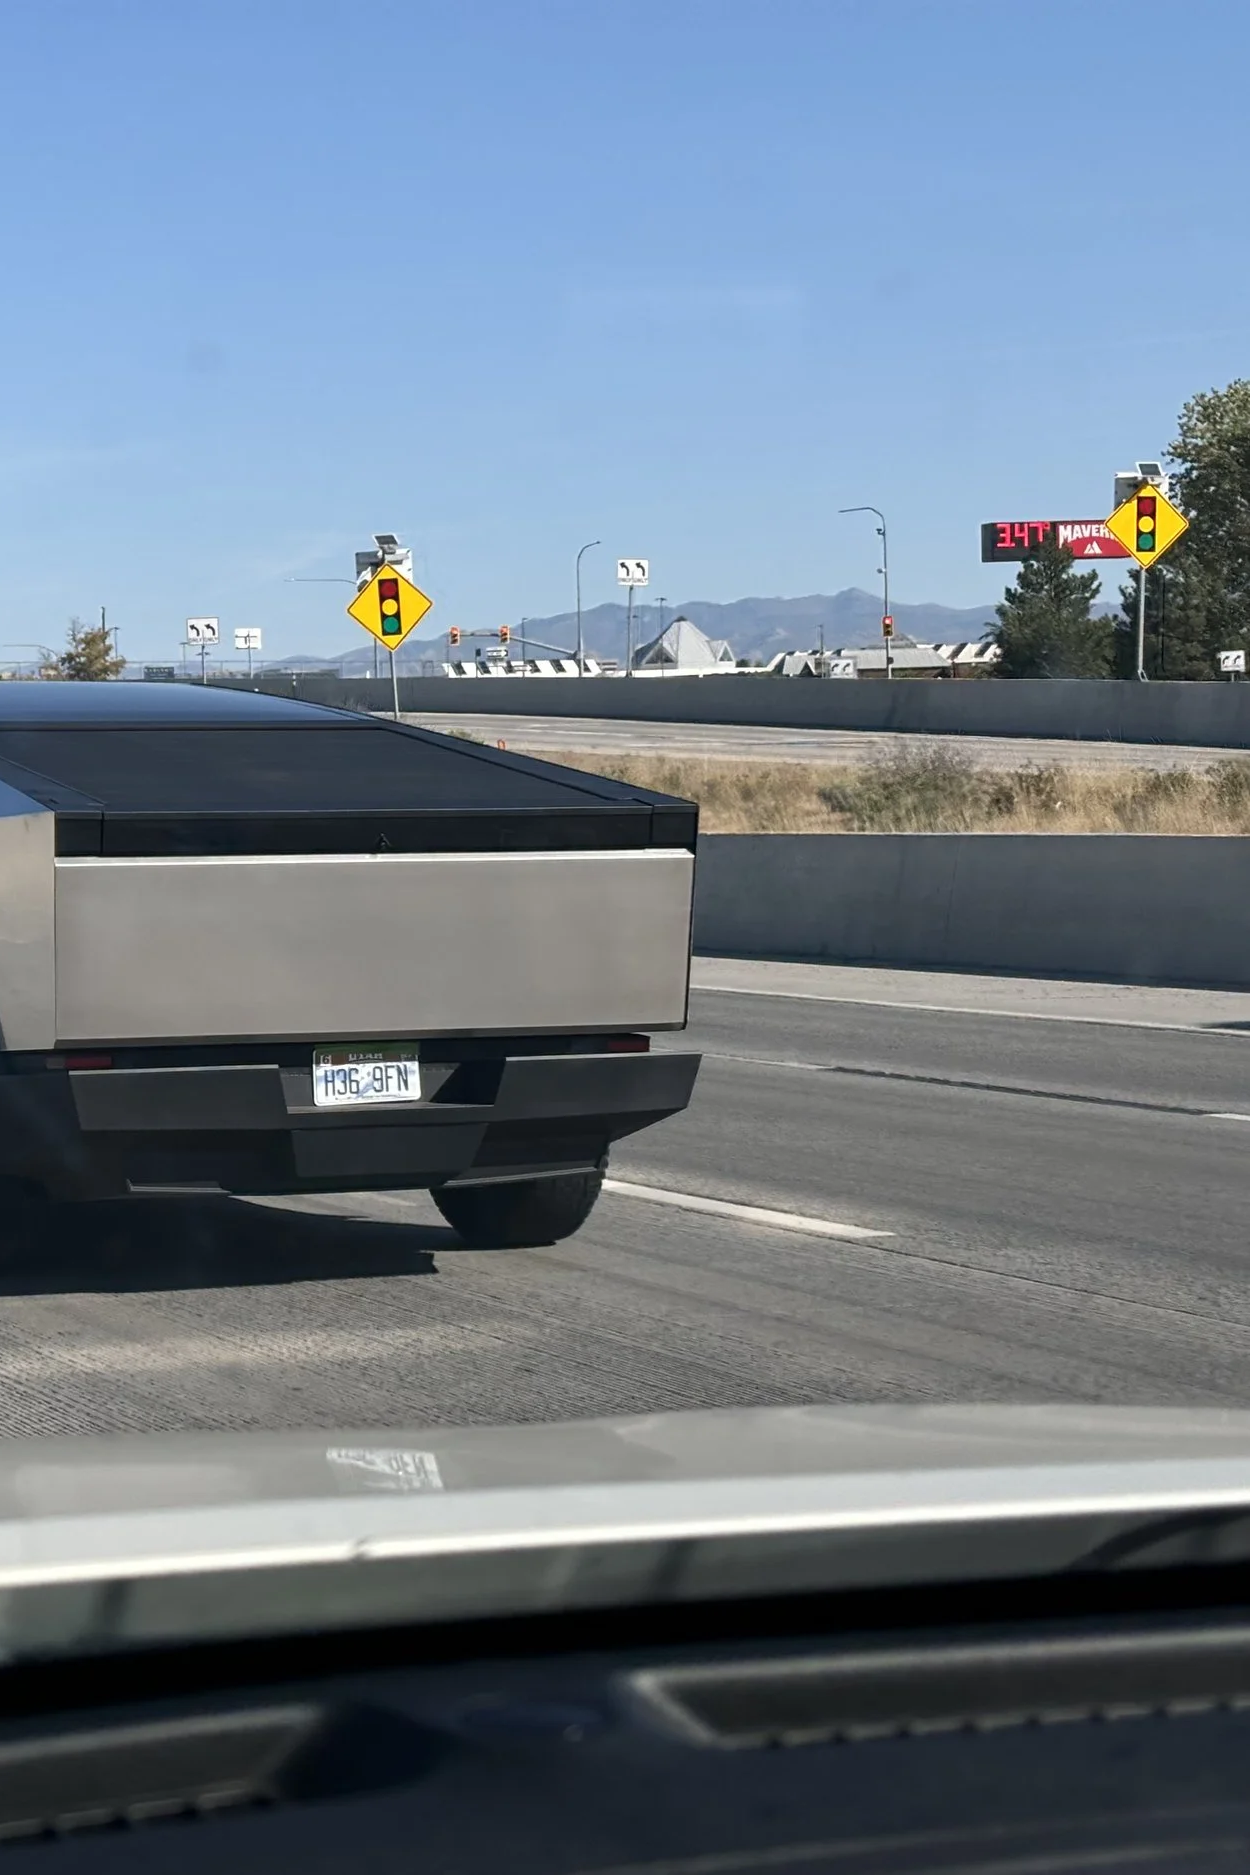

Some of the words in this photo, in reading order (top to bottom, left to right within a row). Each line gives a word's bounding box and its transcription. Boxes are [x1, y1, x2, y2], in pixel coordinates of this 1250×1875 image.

[1058, 524, 1116, 549] MAVER
[324, 1067, 360, 1097] H36
[372, 1064, 409, 1093] 9FN
